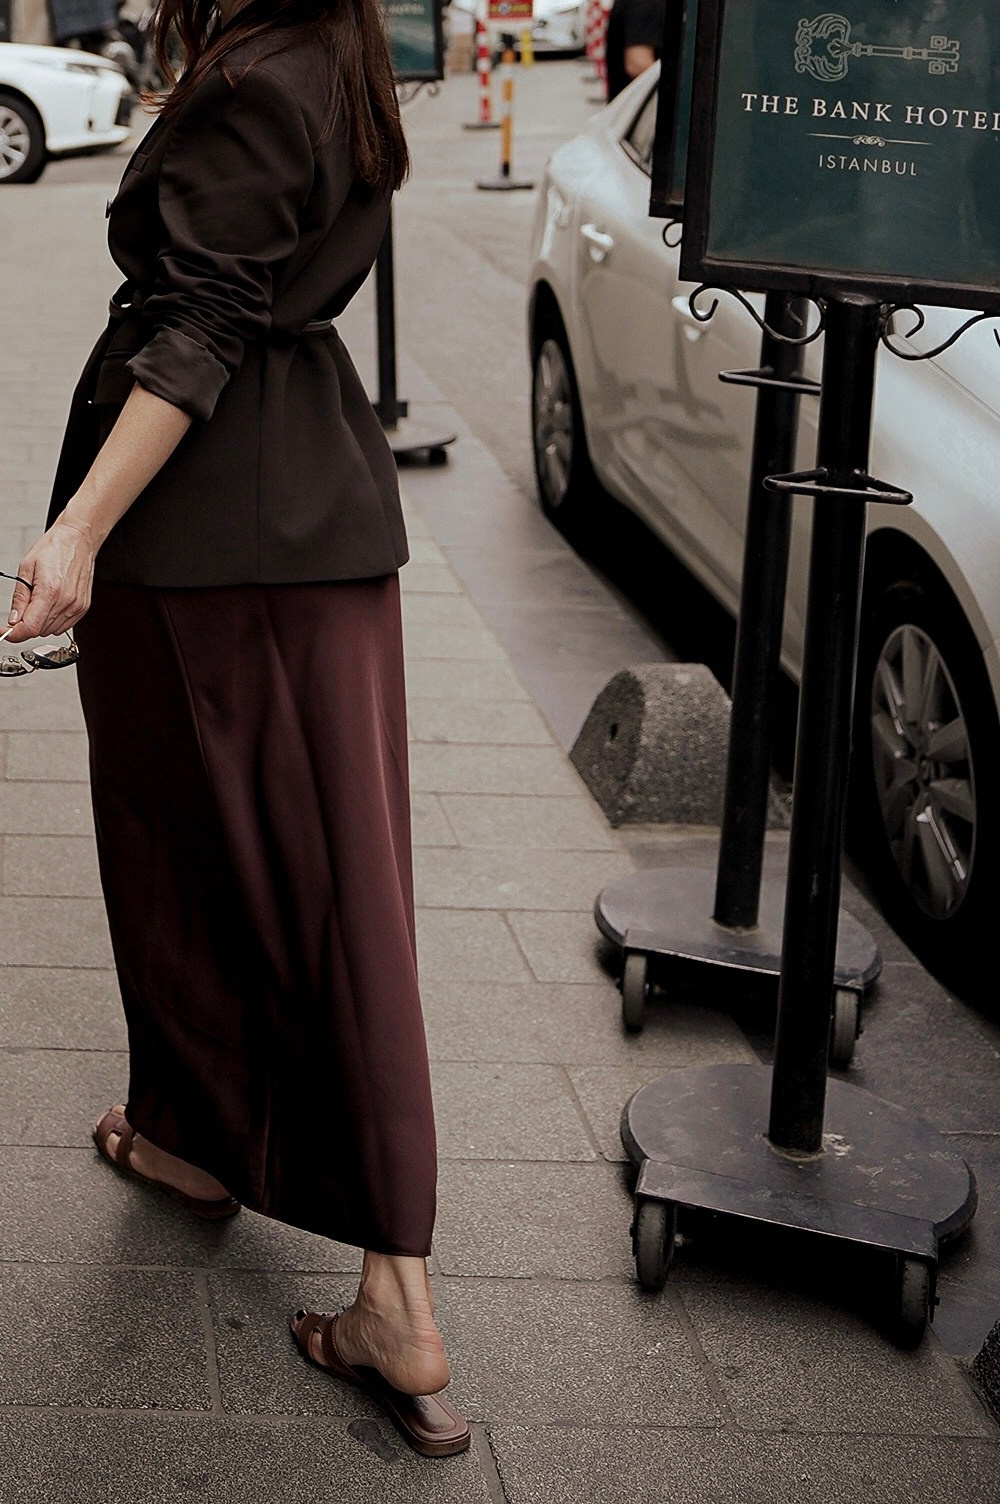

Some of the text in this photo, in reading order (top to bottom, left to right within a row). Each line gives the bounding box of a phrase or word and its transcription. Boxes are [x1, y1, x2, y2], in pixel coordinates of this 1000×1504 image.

[740, 92, 799, 115] THE
[811, 97, 893, 123] BANK
[818, 154, 918, 177] ISTANBUL
